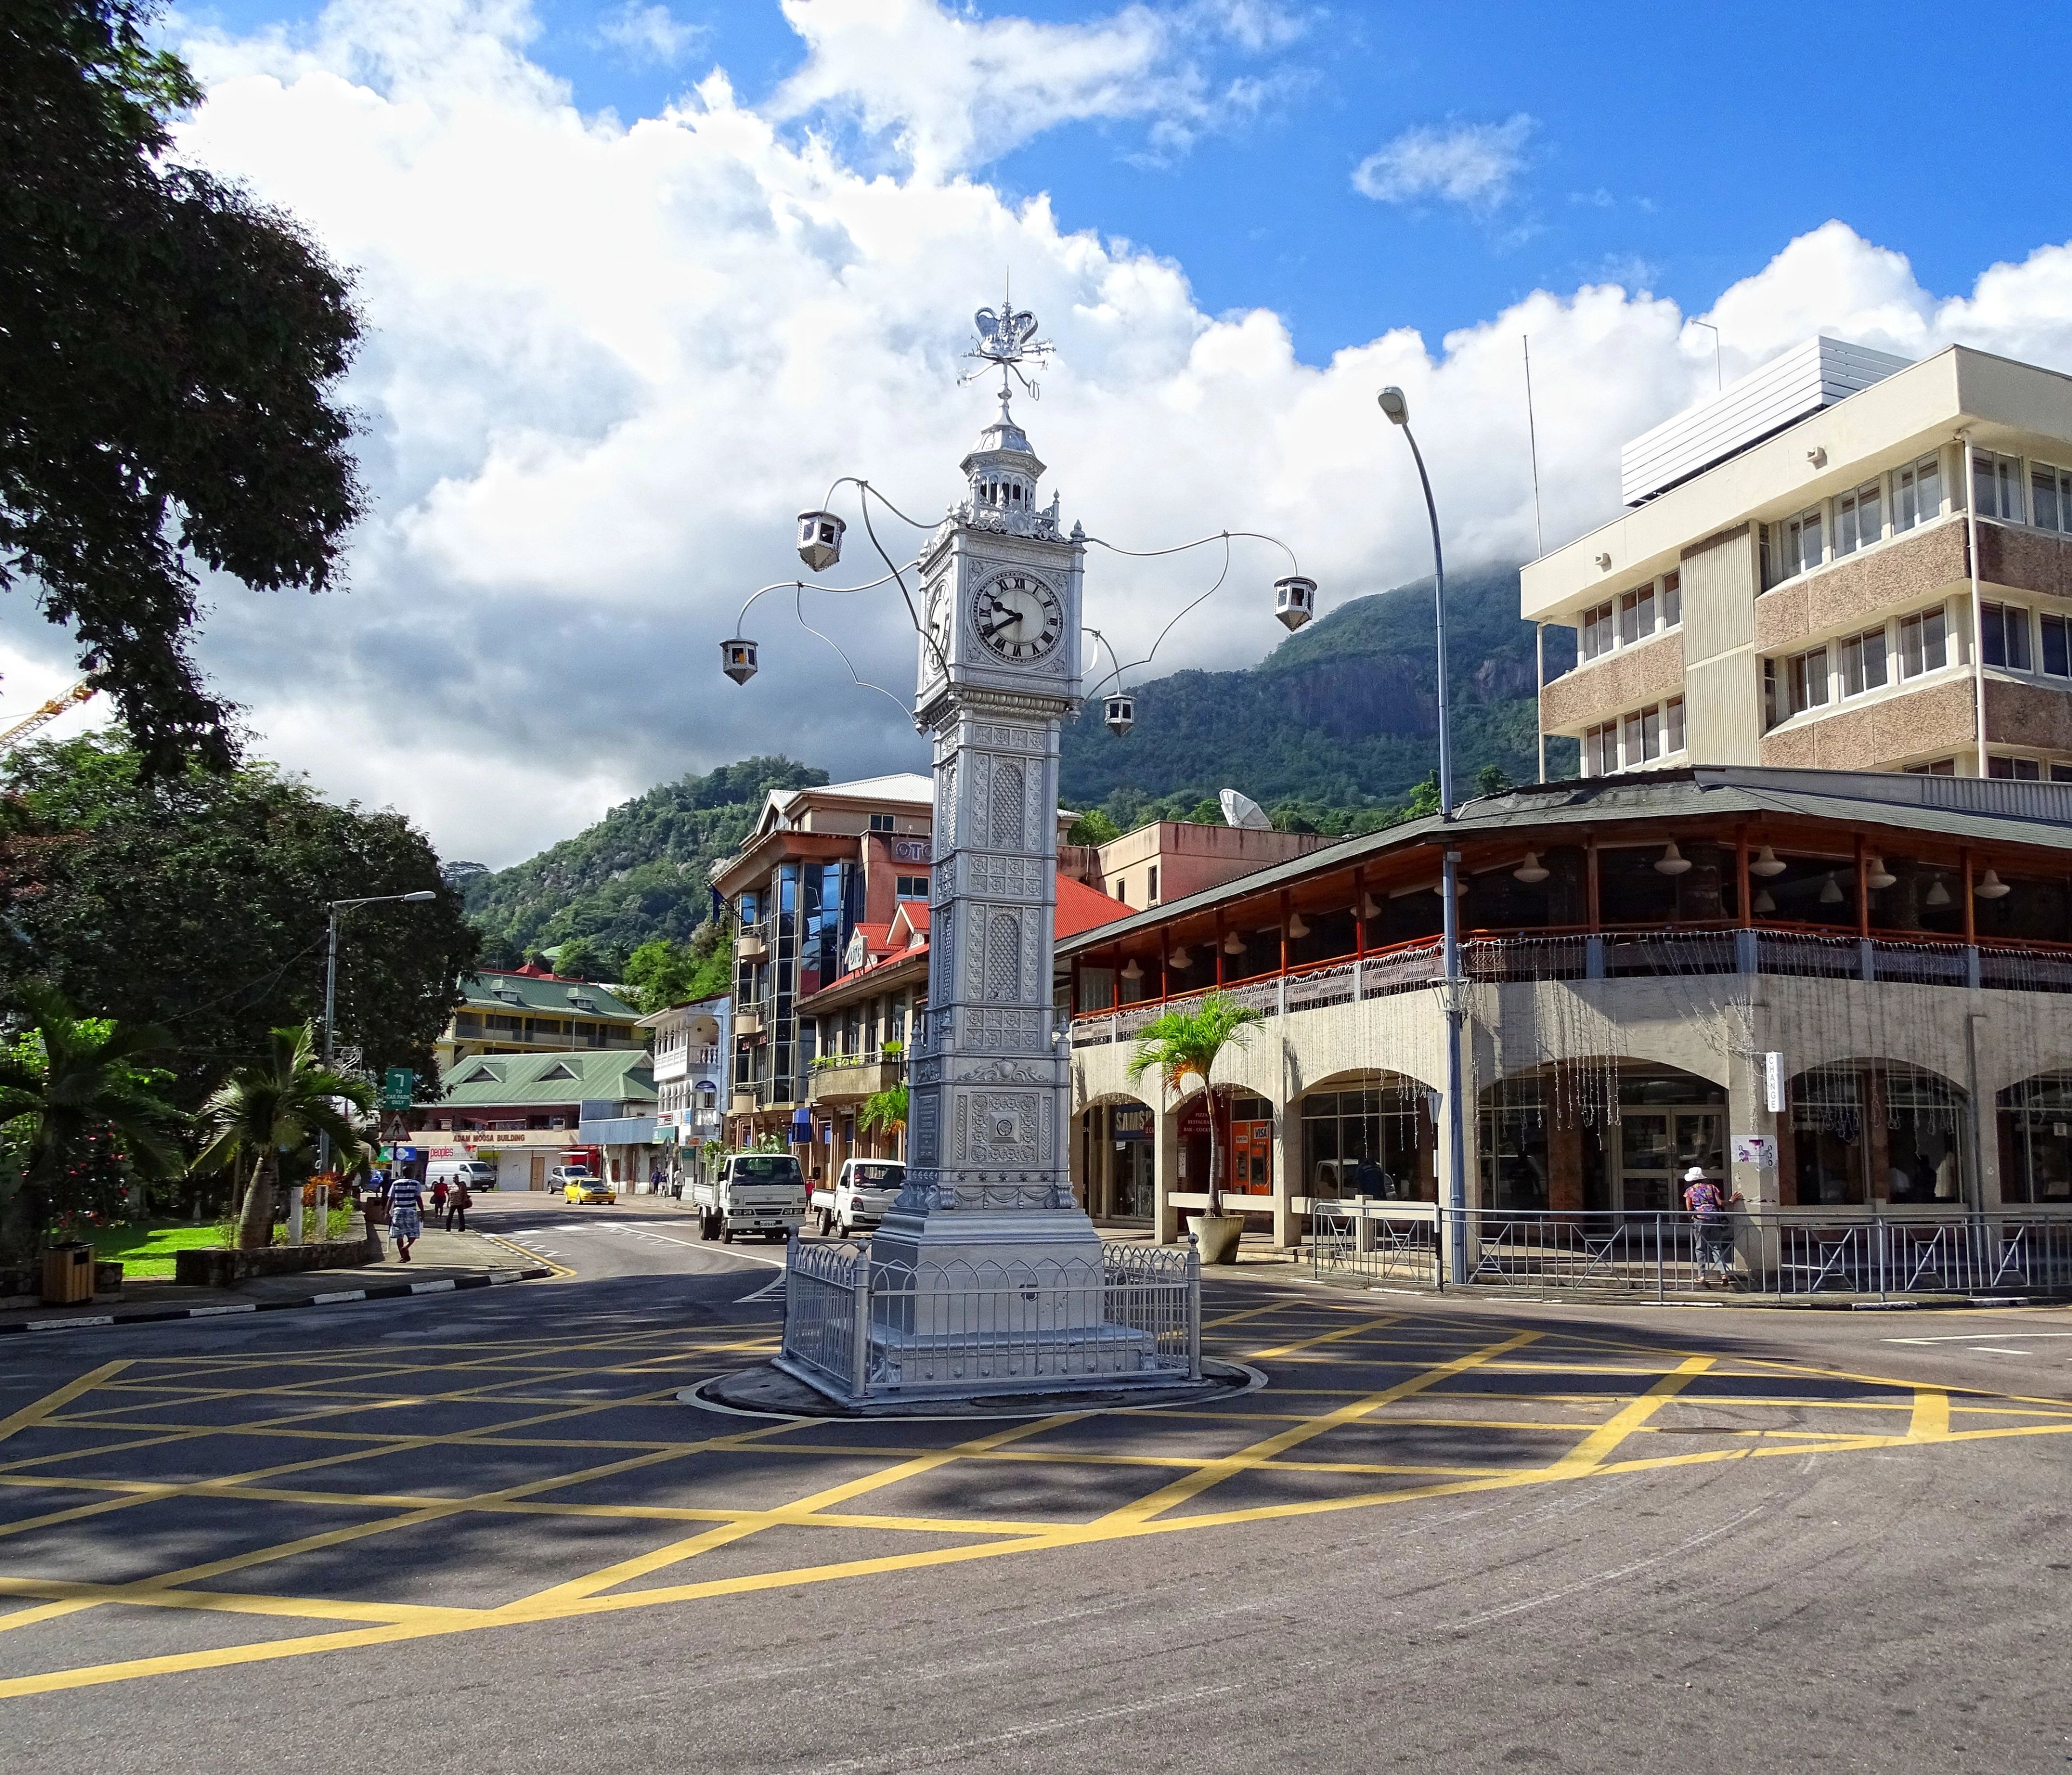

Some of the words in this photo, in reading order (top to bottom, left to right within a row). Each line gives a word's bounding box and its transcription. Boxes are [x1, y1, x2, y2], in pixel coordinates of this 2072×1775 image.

[1768, 1056, 1776, 1108] CHANGE
[1255, 1128, 1267, 1138] VISA
[430, 1146, 453, 1159] peoples
